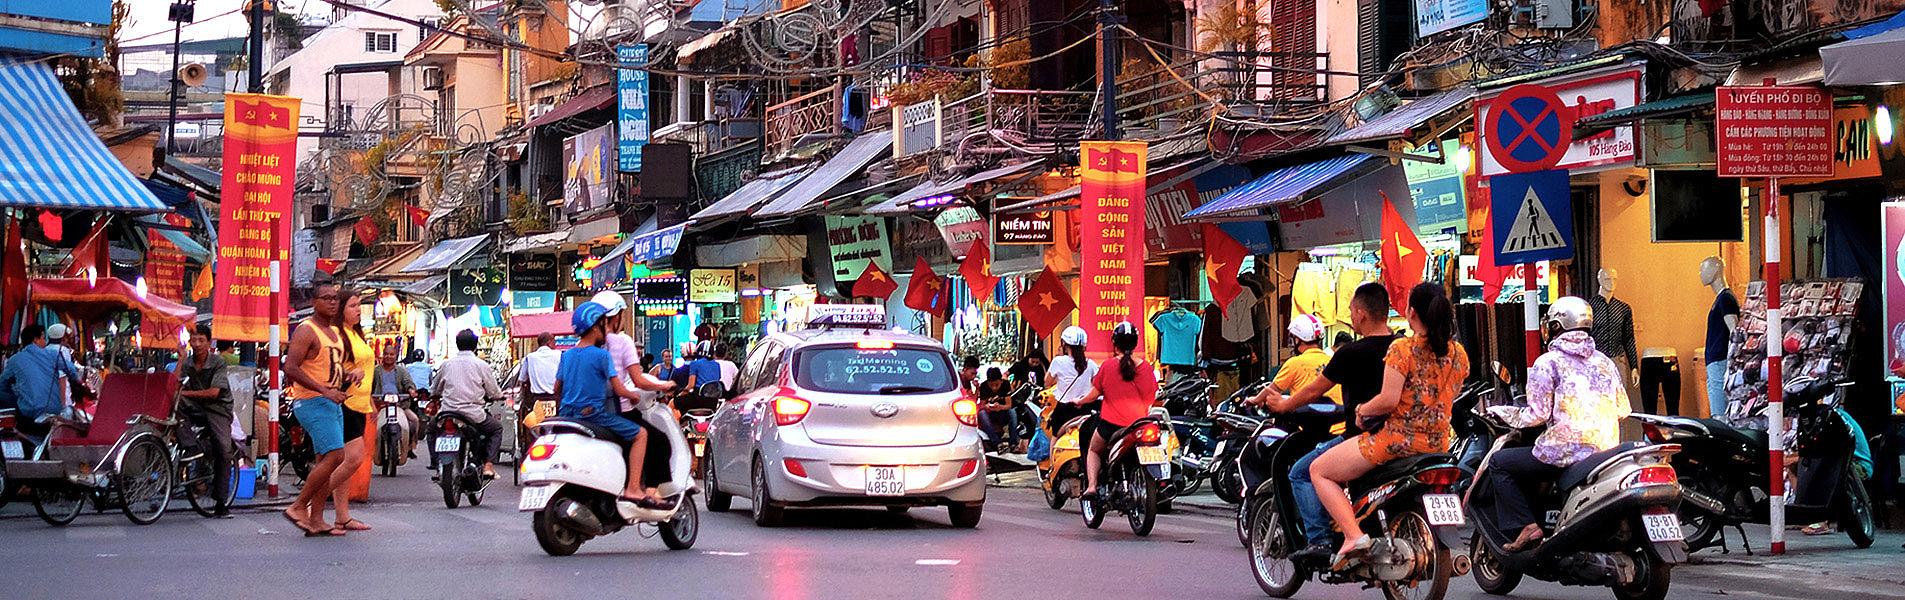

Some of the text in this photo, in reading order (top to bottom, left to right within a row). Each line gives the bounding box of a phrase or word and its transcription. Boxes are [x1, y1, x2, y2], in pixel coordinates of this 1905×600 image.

[1728, 90, 1822, 106] TUYẾN PHỐ ĐI BỘ
[1097, 211, 1129, 224] CỘNG
[1032, 220, 1051, 230] TIN
[1101, 242, 1125, 255] VIỆT
[1100, 259, 1126, 269] NAM
[1093, 275, 1132, 285] QUANG
[1100, 291, 1126, 300] VINH
[652, 320, 666, 330] 79
[875, 468, 896, 480] 30A
[867, 481, 904, 494] 485.02
[1429, 497, 1457, 509] 29-K6
[1433, 510, 1460, 522] 6886
[1648, 515, 1675, 528] 29-B1
